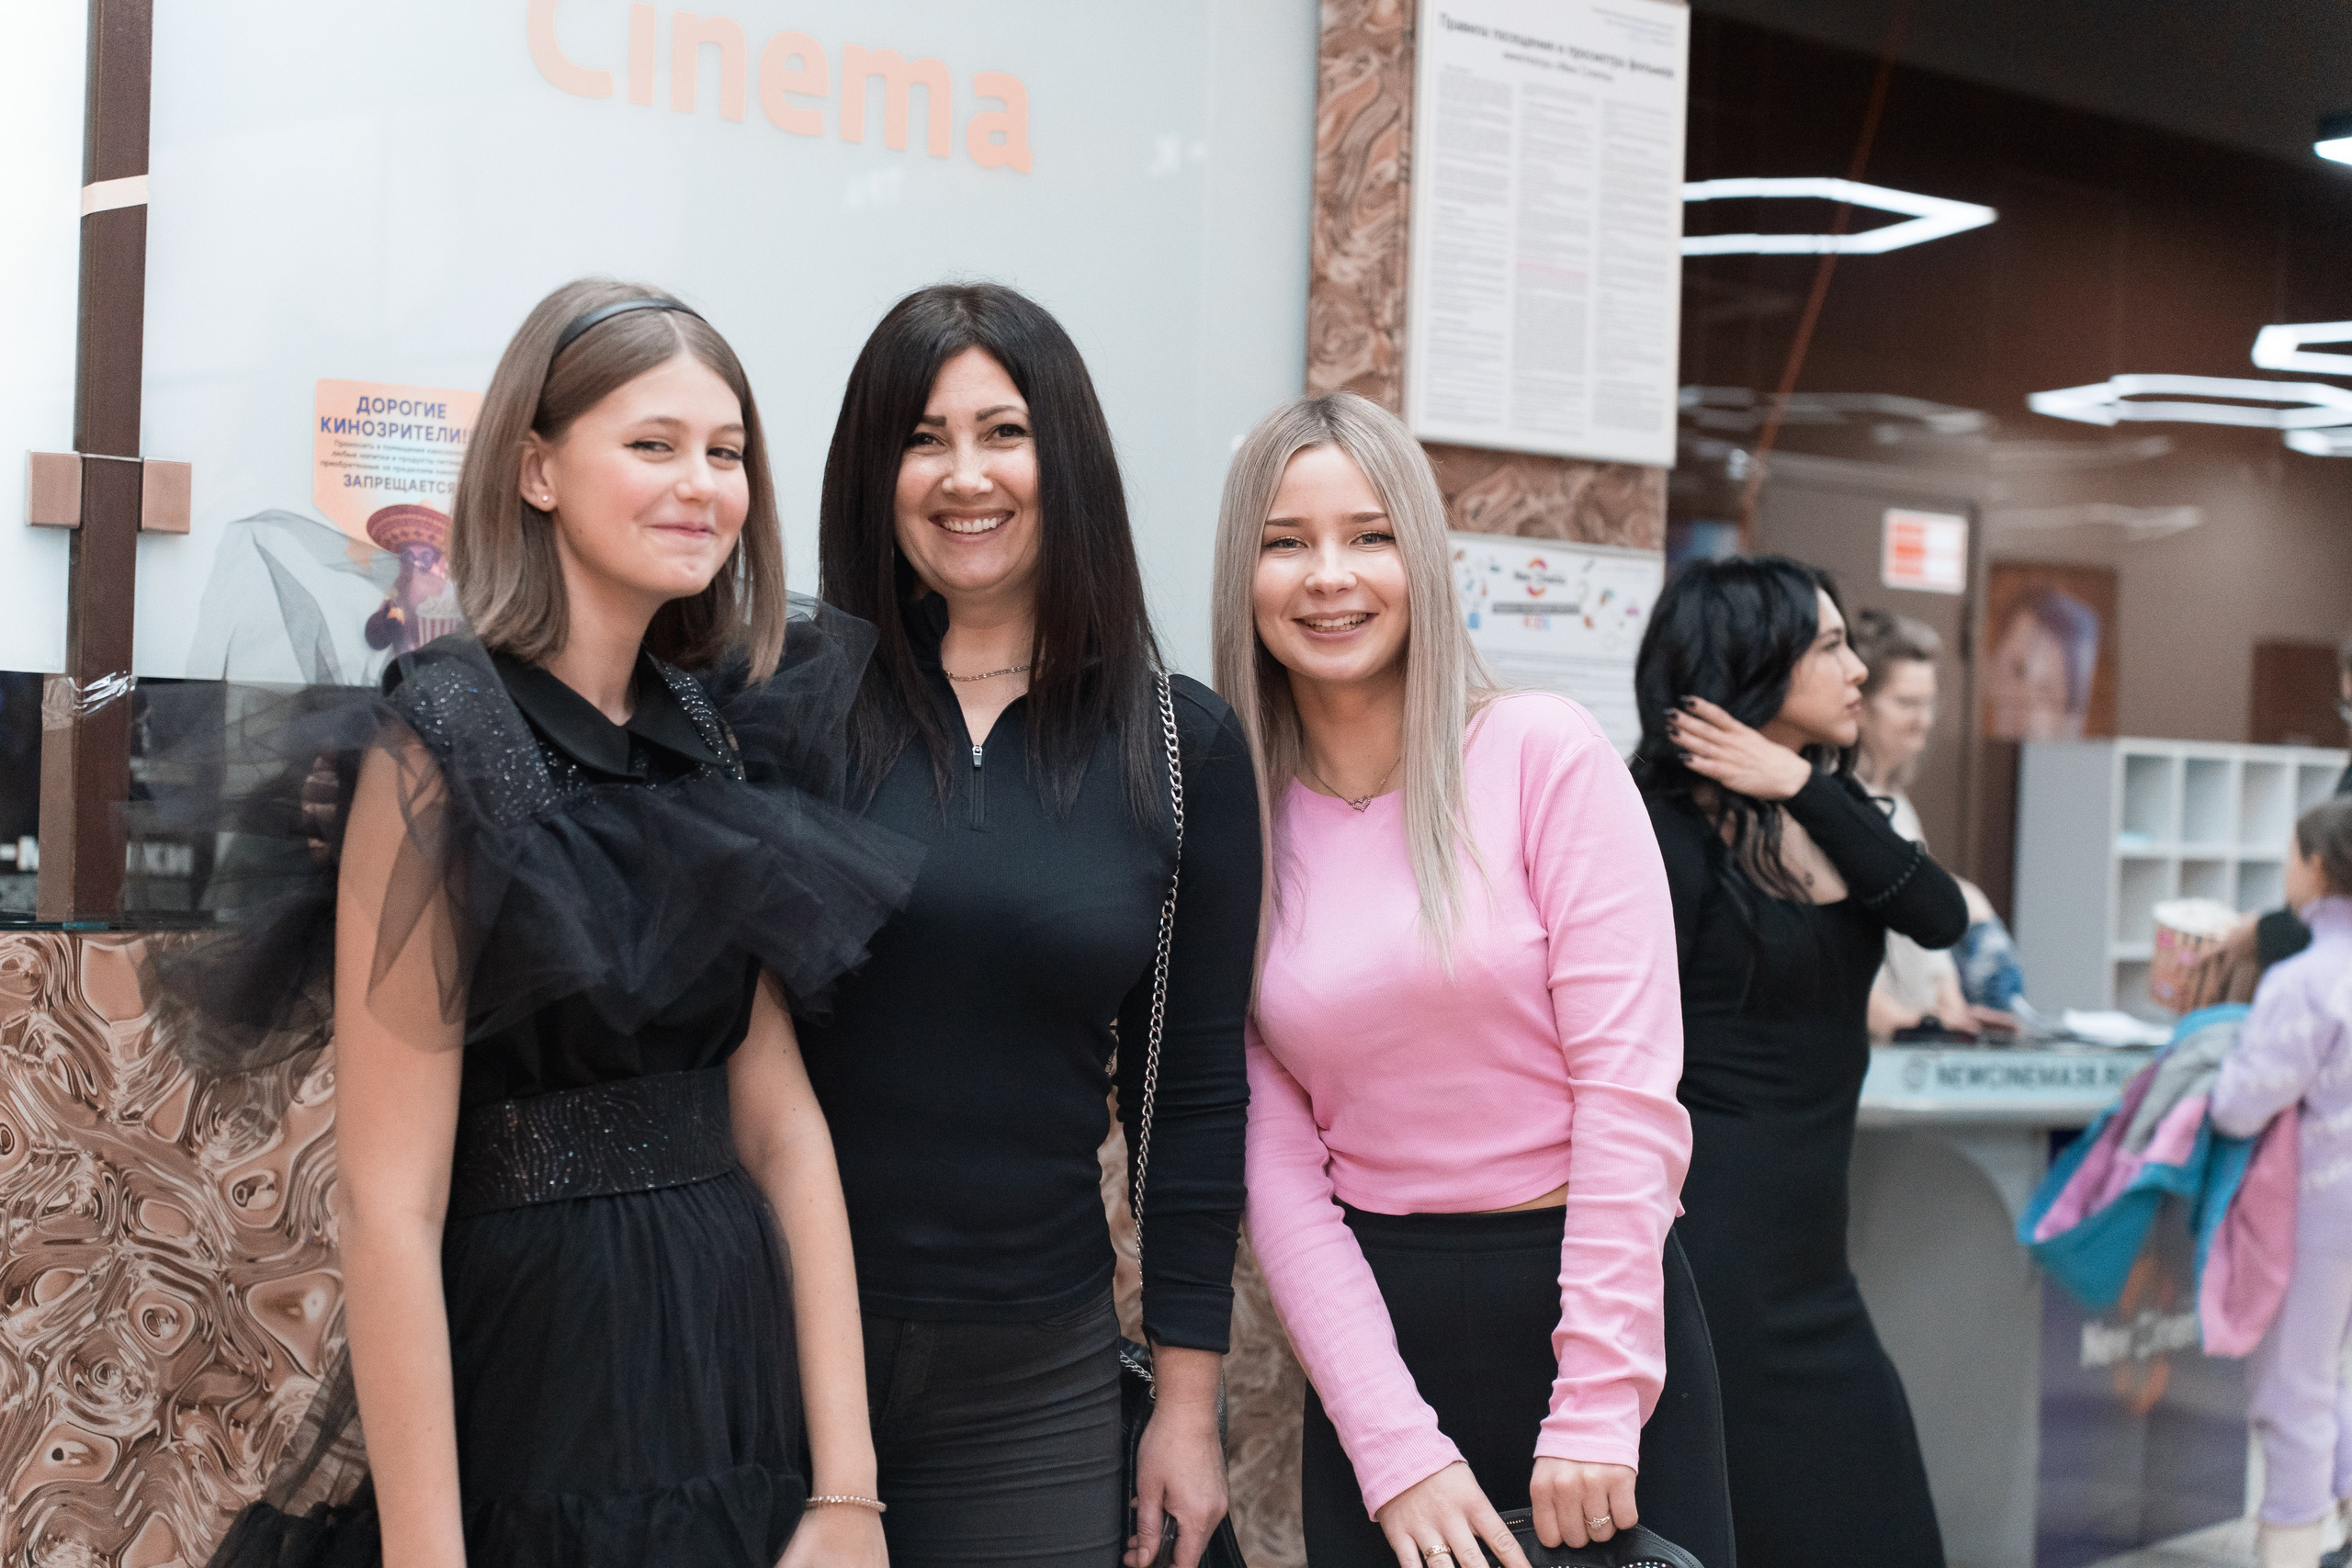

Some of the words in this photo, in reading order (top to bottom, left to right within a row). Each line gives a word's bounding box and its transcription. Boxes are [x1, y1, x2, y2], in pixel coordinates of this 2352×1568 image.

[526, 0, 1034, 175] Cinema
[356, 396, 447, 420] ДОРОГИЕ
[343, 474, 456, 494] ЗАПРЕЩАЕТСЯ
